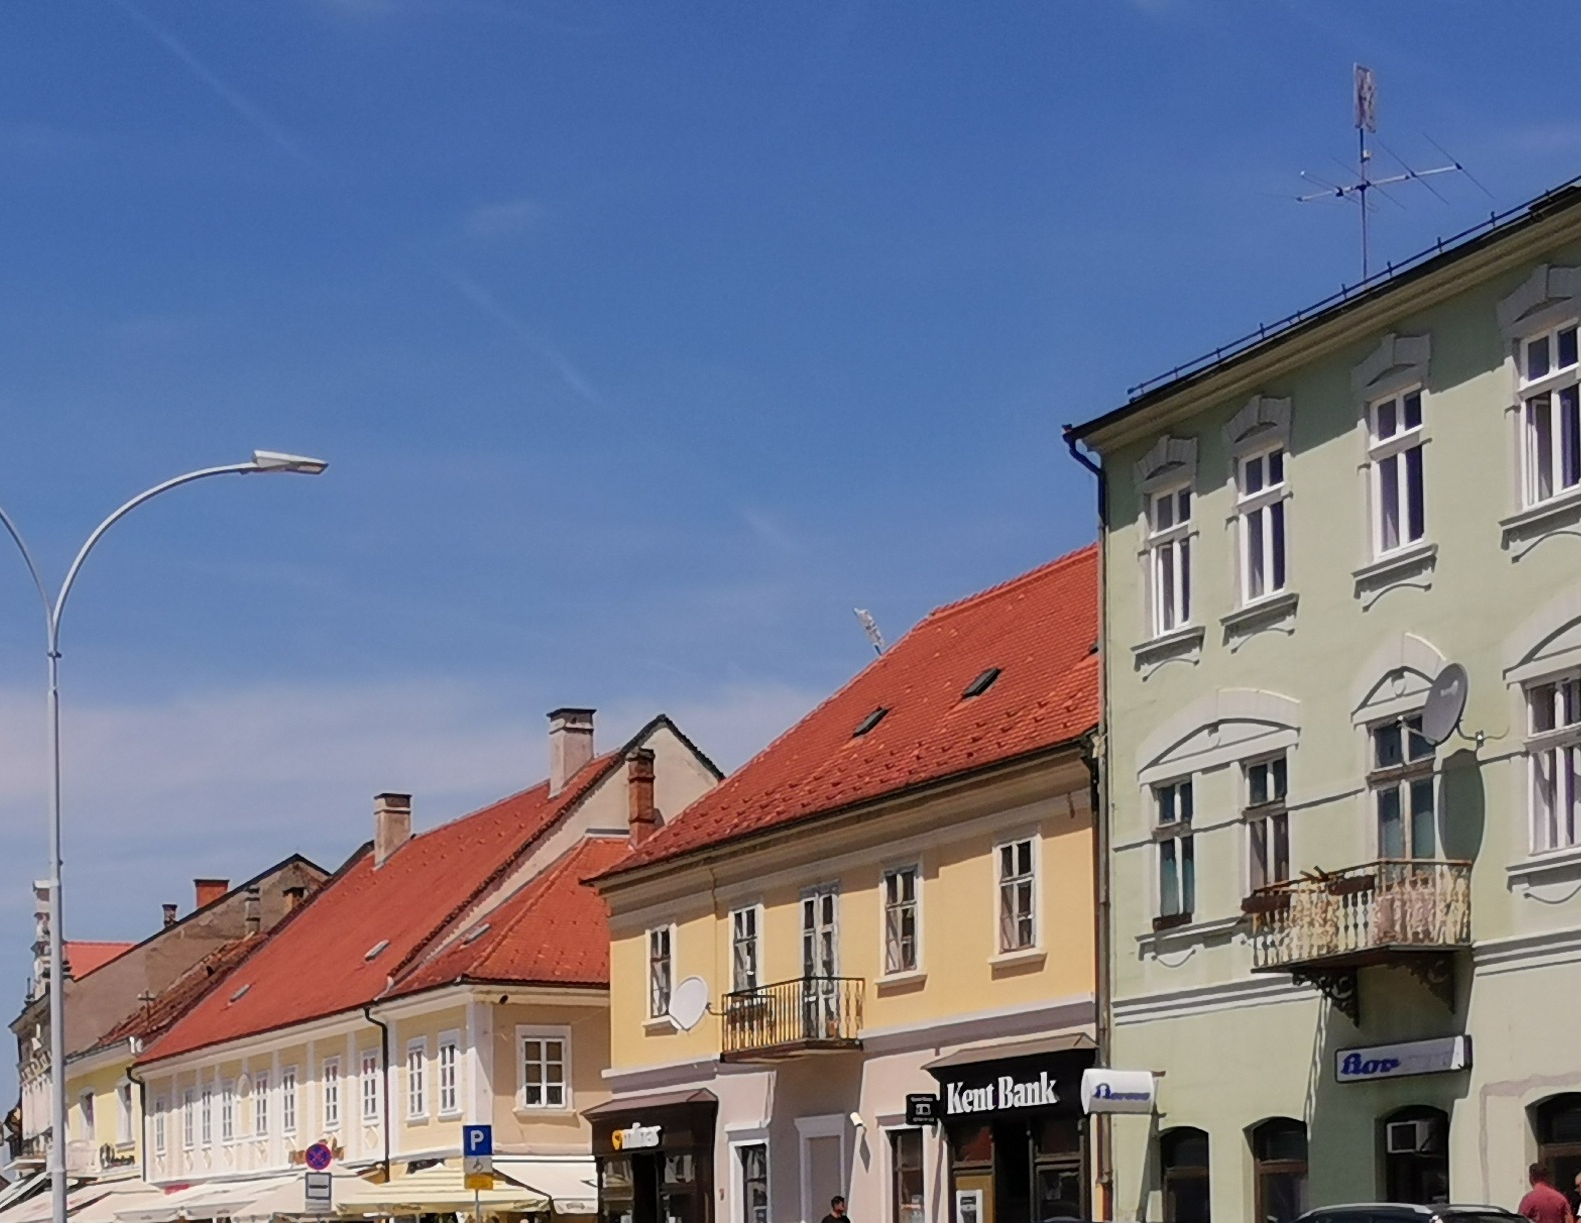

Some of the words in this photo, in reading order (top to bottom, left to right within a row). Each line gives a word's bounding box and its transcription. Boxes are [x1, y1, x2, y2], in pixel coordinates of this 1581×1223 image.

[946, 1080, 995, 1115] Kent
[997, 1071, 1059, 1110] Bank
[470, 1129, 485, 1152] P
